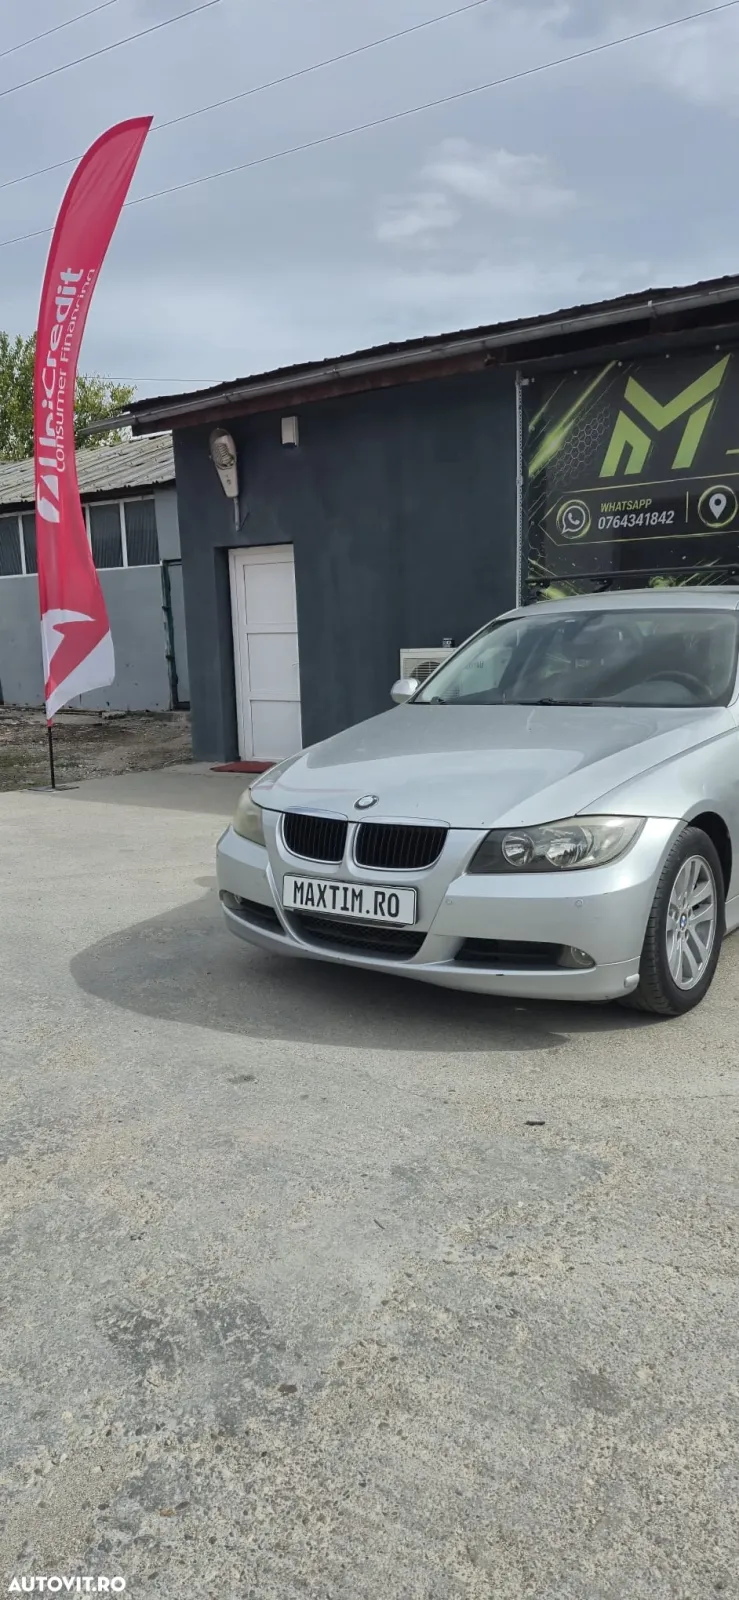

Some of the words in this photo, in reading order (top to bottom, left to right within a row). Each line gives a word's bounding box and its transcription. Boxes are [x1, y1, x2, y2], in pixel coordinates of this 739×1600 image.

[600, 498, 652, 513] WHATSAPP
[597, 510, 675, 530] 0764341842
[293, 880, 400, 918] MAXTIM.RO
